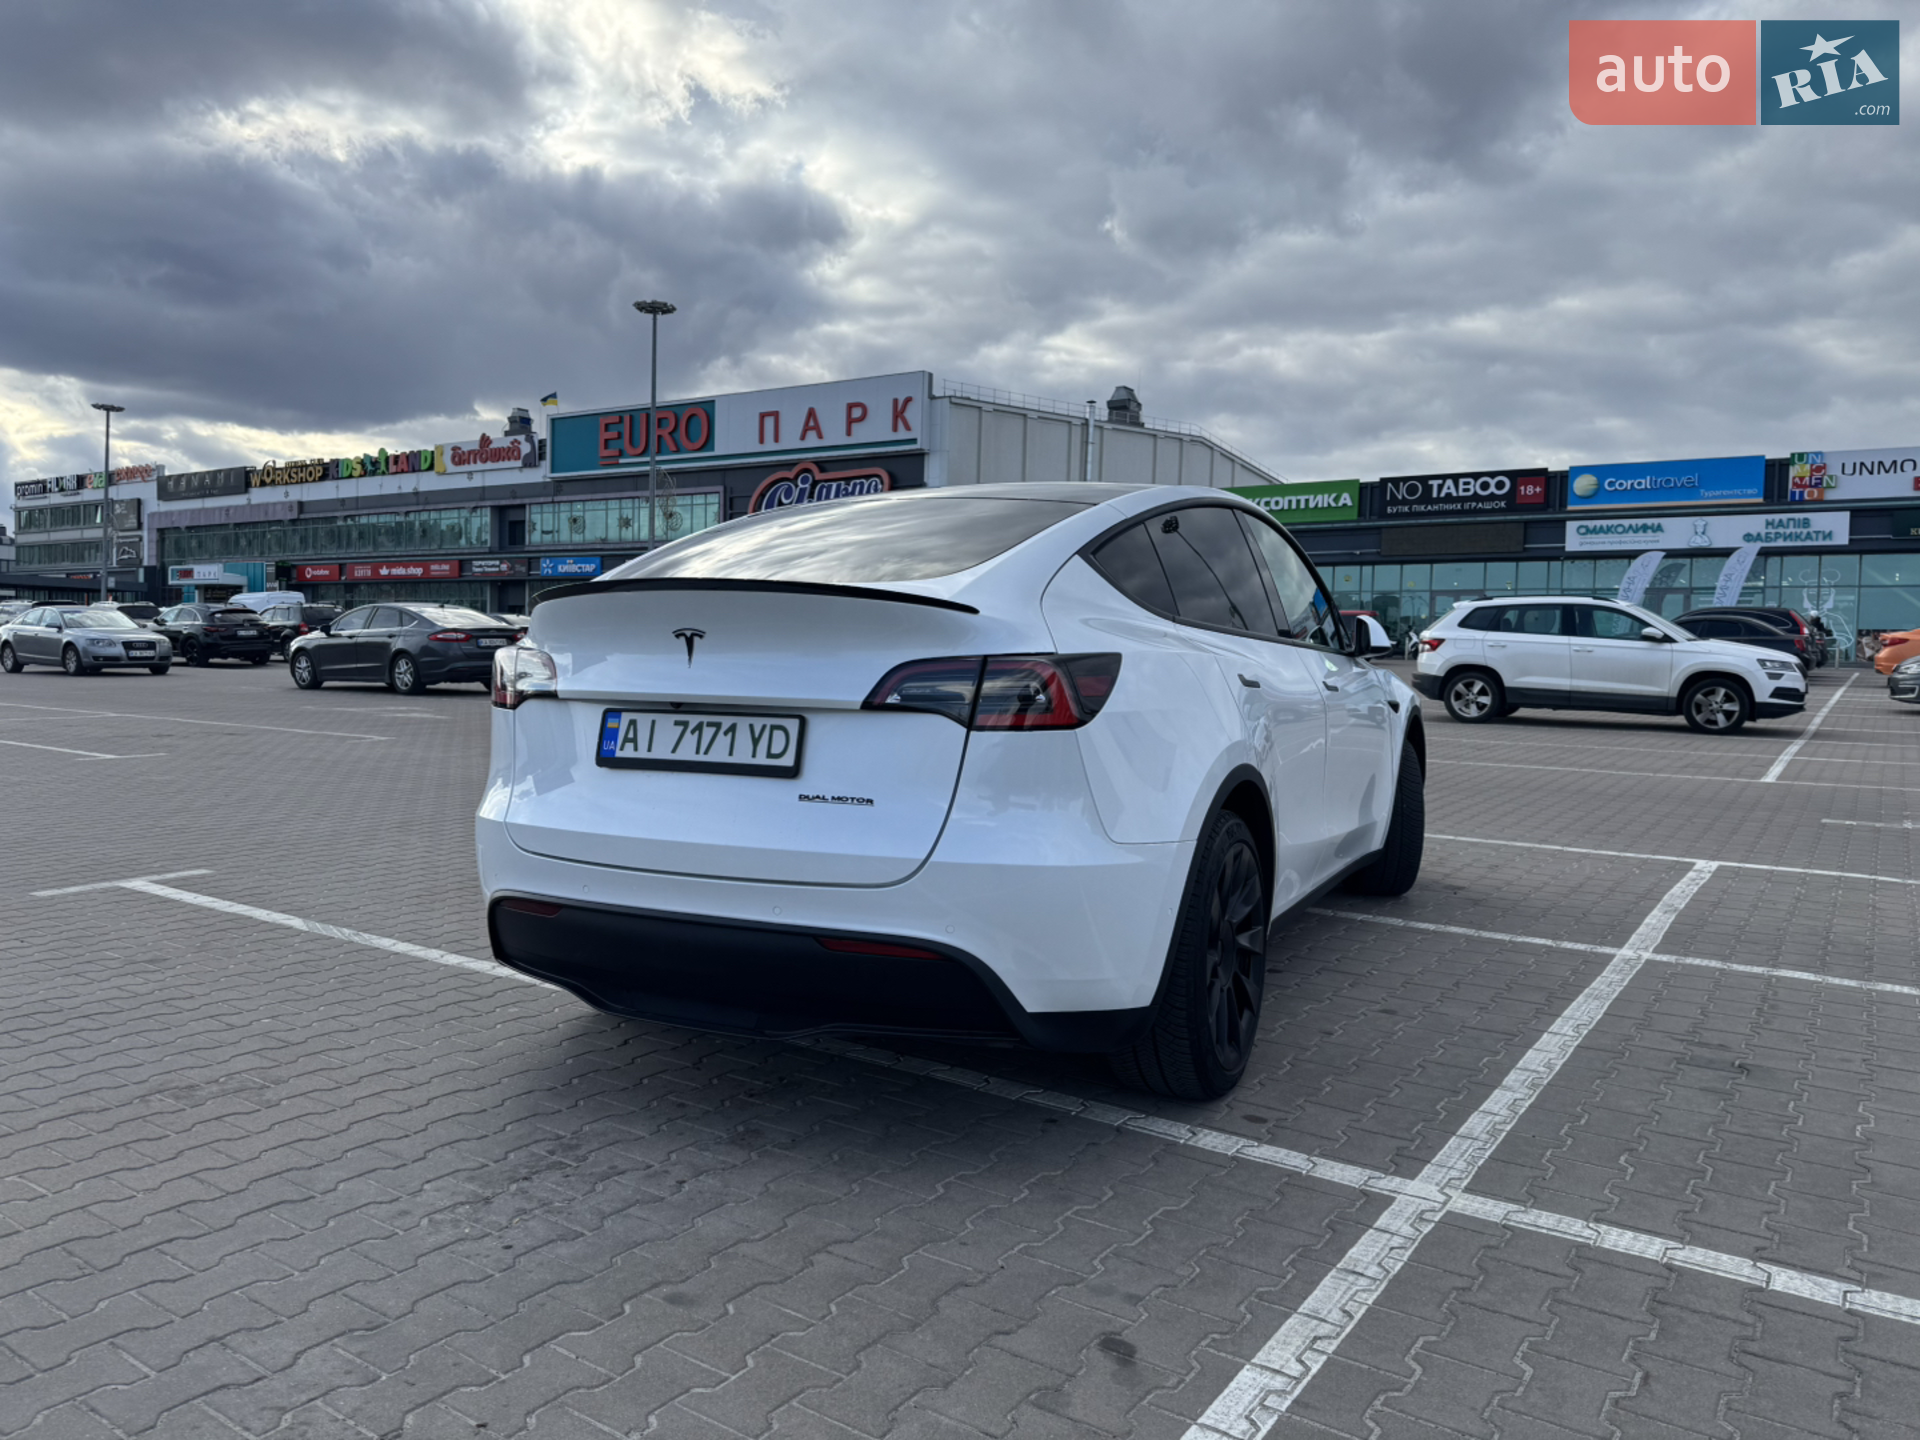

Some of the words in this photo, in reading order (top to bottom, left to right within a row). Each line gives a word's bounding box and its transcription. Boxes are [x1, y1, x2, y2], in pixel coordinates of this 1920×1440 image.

[758, 396, 913, 446] ПАРК
[599, 406, 710, 459] EURO
[250, 466, 323, 488] WORKSHOP
[1386, 480, 1423, 501] NO
[1428, 475, 1511, 498] TABOO
[1519, 484, 1543, 496] 18+
[1700, 488, 1759, 498] Турагентство
[1386, 505, 1410, 514] БУТІК
[1411, 503, 1461, 513] ПІКАНТНИХ
[1463, 500, 1507, 511] ІГРАШОК
[1576, 522, 1665, 536] СМАКОЛИНА
[1764, 517, 1812, 530] НАПІВ
[1742, 530, 1834, 544] ФАБРИКАТИ
[557, 561, 596, 574] КИЇВСТАР
[603, 739, 616, 751] UA
[619, 718, 656, 753] AI
[670, 720, 738, 757] 7171
[748, 723, 790, 760] YD
[798, 794, 829, 802] DUAL
[831, 795, 874, 805] MOTOR
